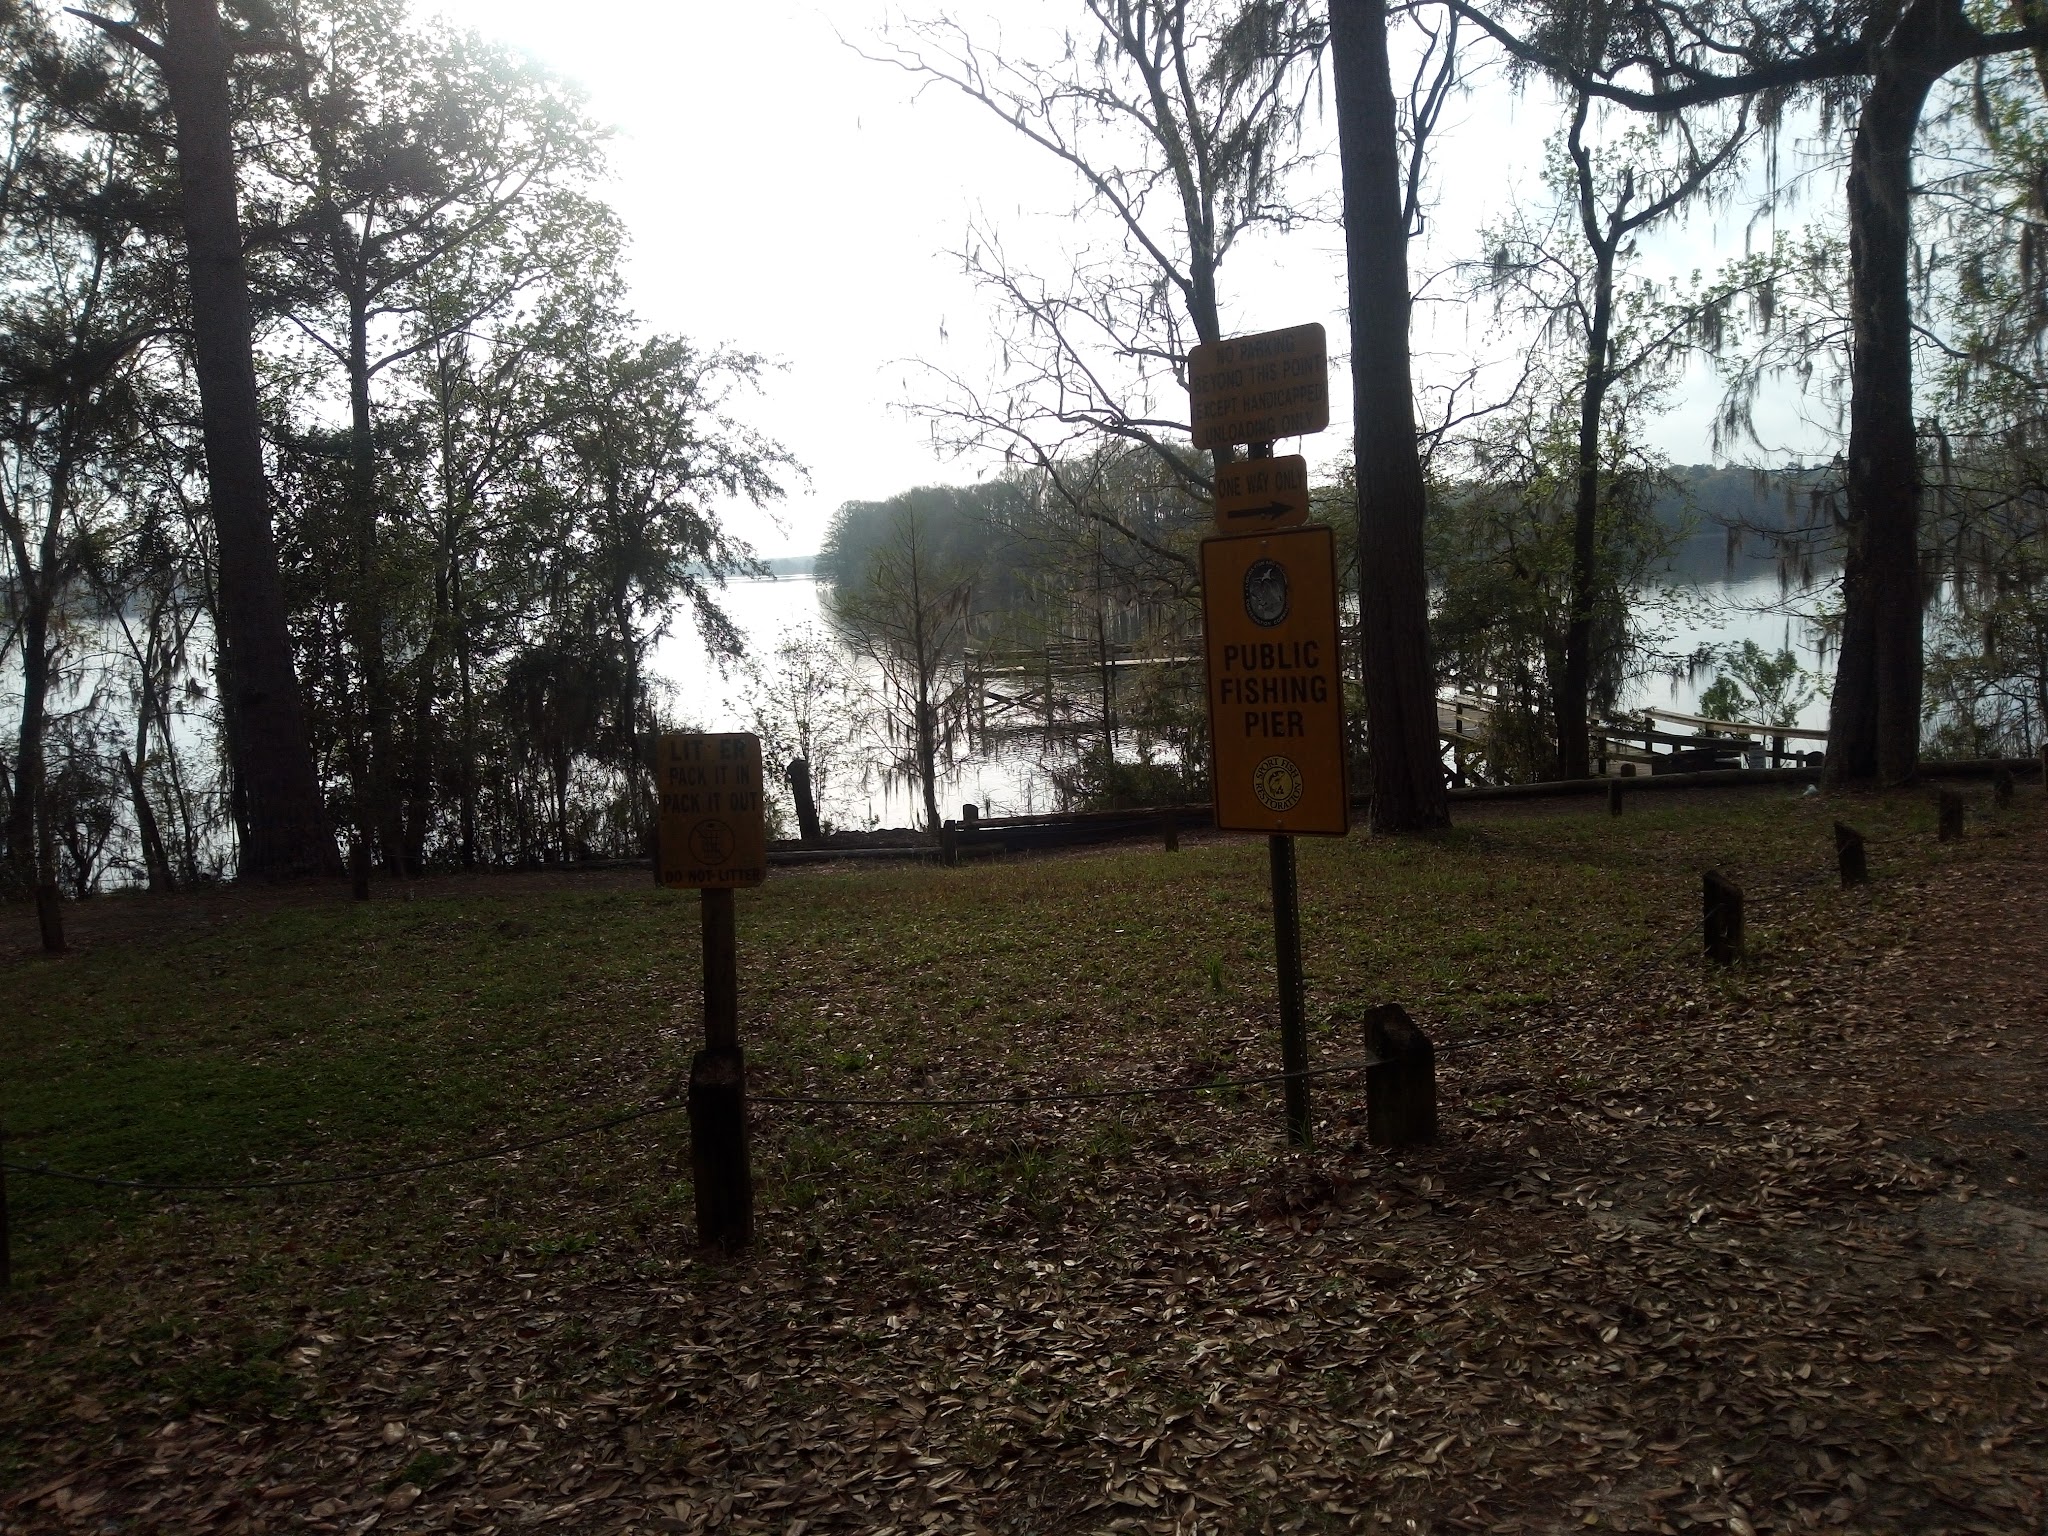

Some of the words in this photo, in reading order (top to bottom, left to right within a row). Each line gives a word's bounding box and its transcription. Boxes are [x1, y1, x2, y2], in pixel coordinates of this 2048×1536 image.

[1216, 345, 1234, 366] NO
[1240, 334, 1295, 359] PARKING
[1193, 370, 1243, 394] BEYOND
[1249, 363, 1277, 386] THIS
[1283, 354, 1321, 378] POINT
[1196, 398, 1237, 420] EXCEPT
[1243, 384, 1325, 412] HANDICAPPED
[1205, 417, 1276, 446] UNLOADING
[1281, 412, 1314, 433] ONLY
[1218, 477, 1241, 498] ONE
[1247, 471, 1269, 494] WAY
[1275, 469, 1303, 491] ONLY
[1224, 640, 1319, 671] PUBLIC
[1220, 675, 1327, 705] FISHING
[1245, 711, 1305, 738] PIER
[669, 766, 706, 785] PACK
[715, 766, 728, 784] IT
[736, 764, 750, 784] IN
[1256, 758, 1279, 779] SPORT
[1281, 759, 1299, 778] FISH
[663, 793, 701, 814] PACK
[706, 793, 721, 811] IT
[730, 791, 758, 811] OUT
[1255, 782, 1301, 809] RESTORATION
[665, 870, 682, 883] DO
[689, 869, 713, 882] NOT
[719, 867, 760, 882] LITTER
